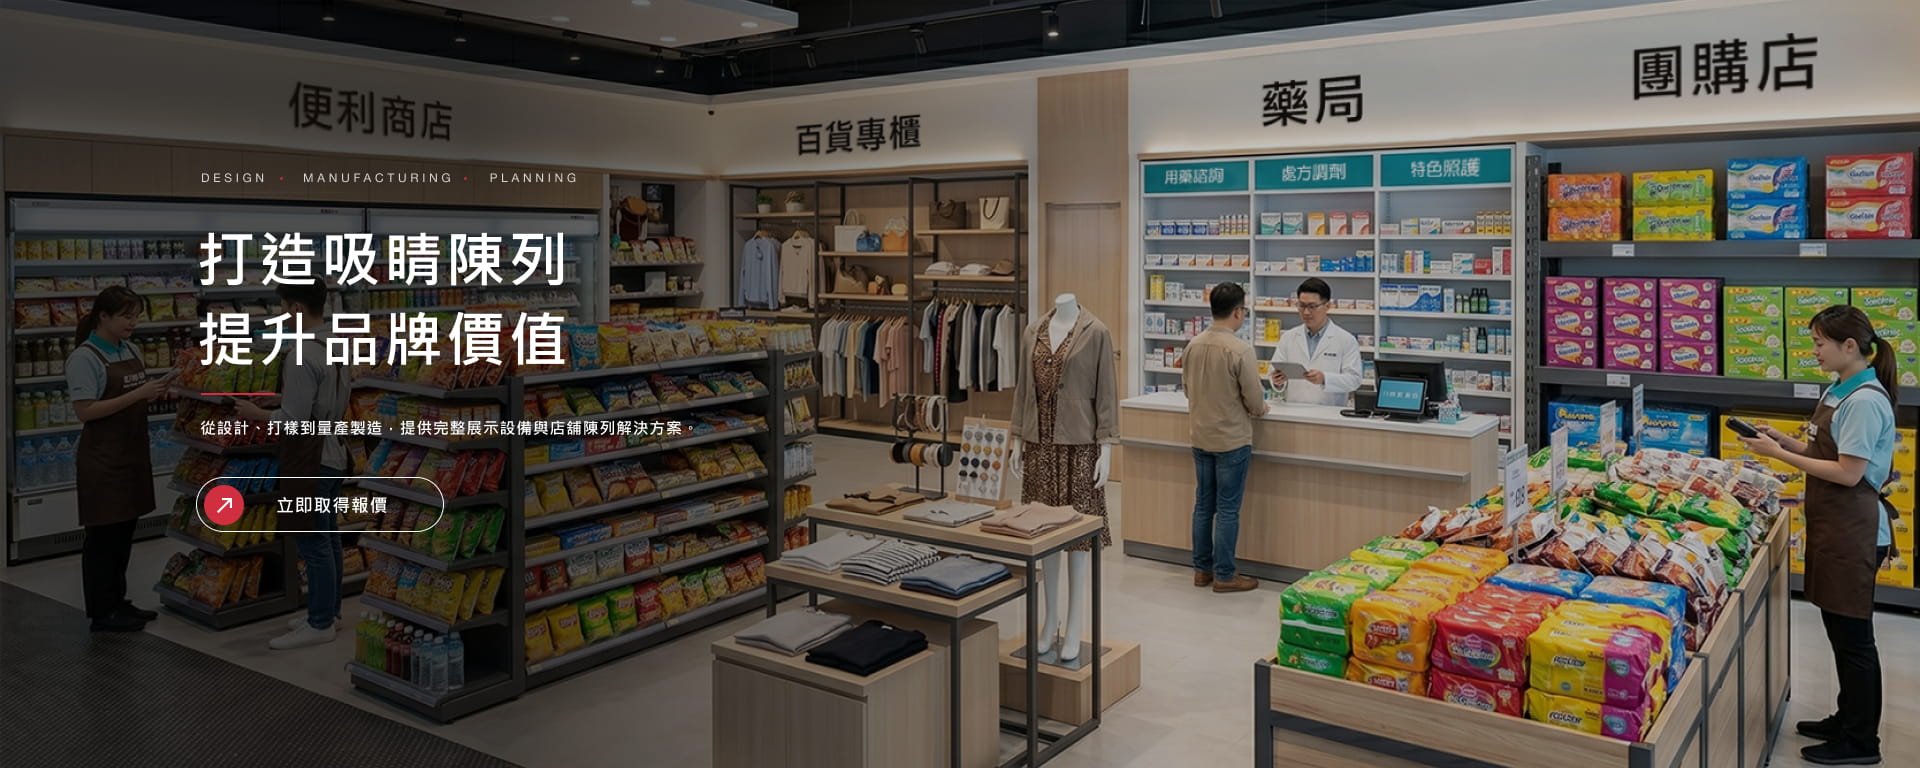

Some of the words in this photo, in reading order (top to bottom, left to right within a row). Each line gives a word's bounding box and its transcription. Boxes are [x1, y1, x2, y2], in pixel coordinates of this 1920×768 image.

[1633, 33, 1818, 101] 團購店
[289, 81, 453, 142] 便利商店
[1262, 74, 1364, 127] 藥局
[796, 114, 921, 155] 百貨專櫃
[1410, 157, 1481, 178] 特色照護
